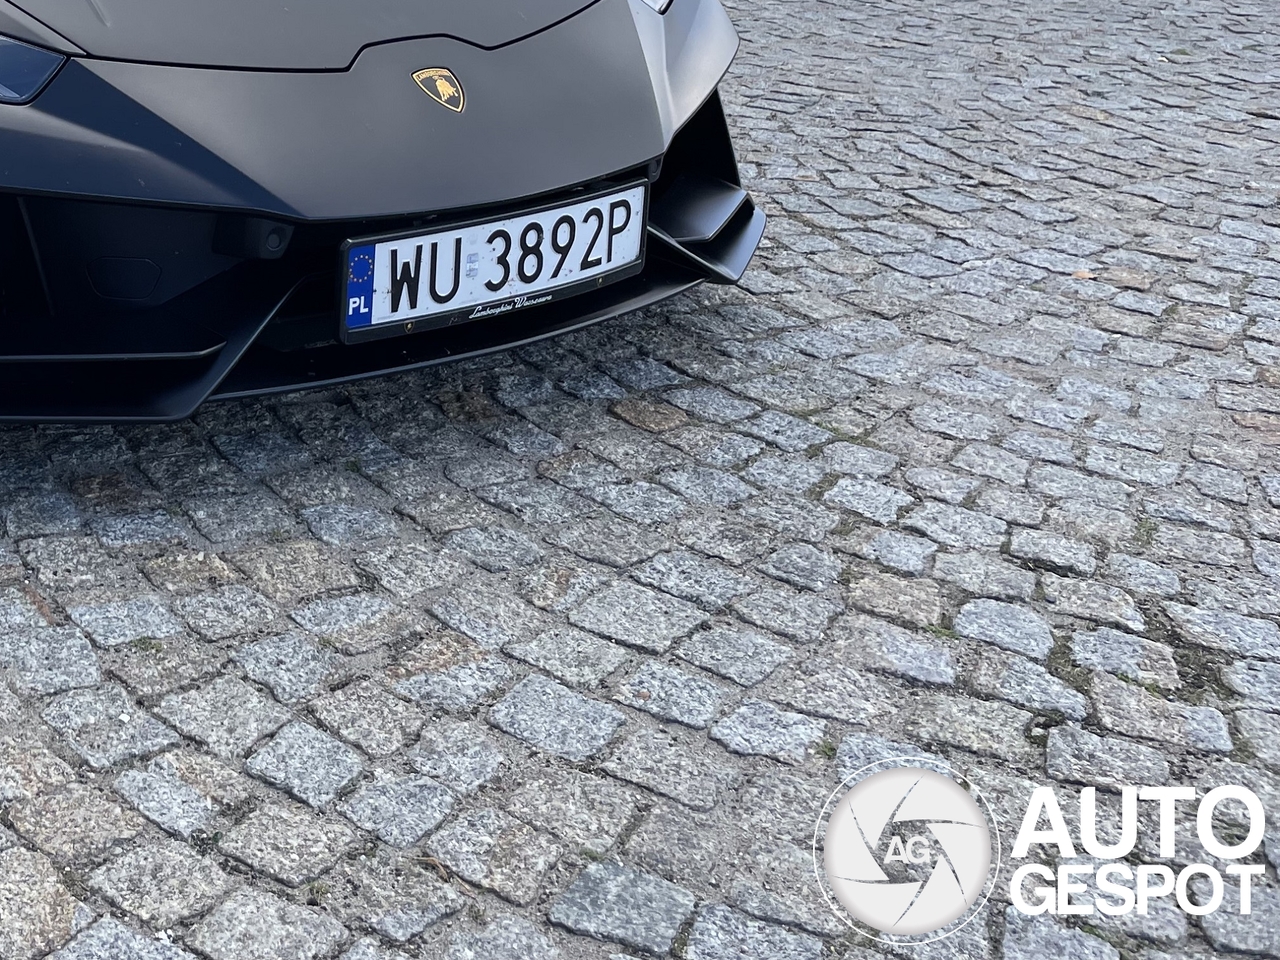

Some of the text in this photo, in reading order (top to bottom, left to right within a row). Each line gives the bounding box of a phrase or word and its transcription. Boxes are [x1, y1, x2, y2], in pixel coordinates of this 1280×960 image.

[390, 199, 632, 313] WU 3892P
[348, 296, 369, 316] PL
